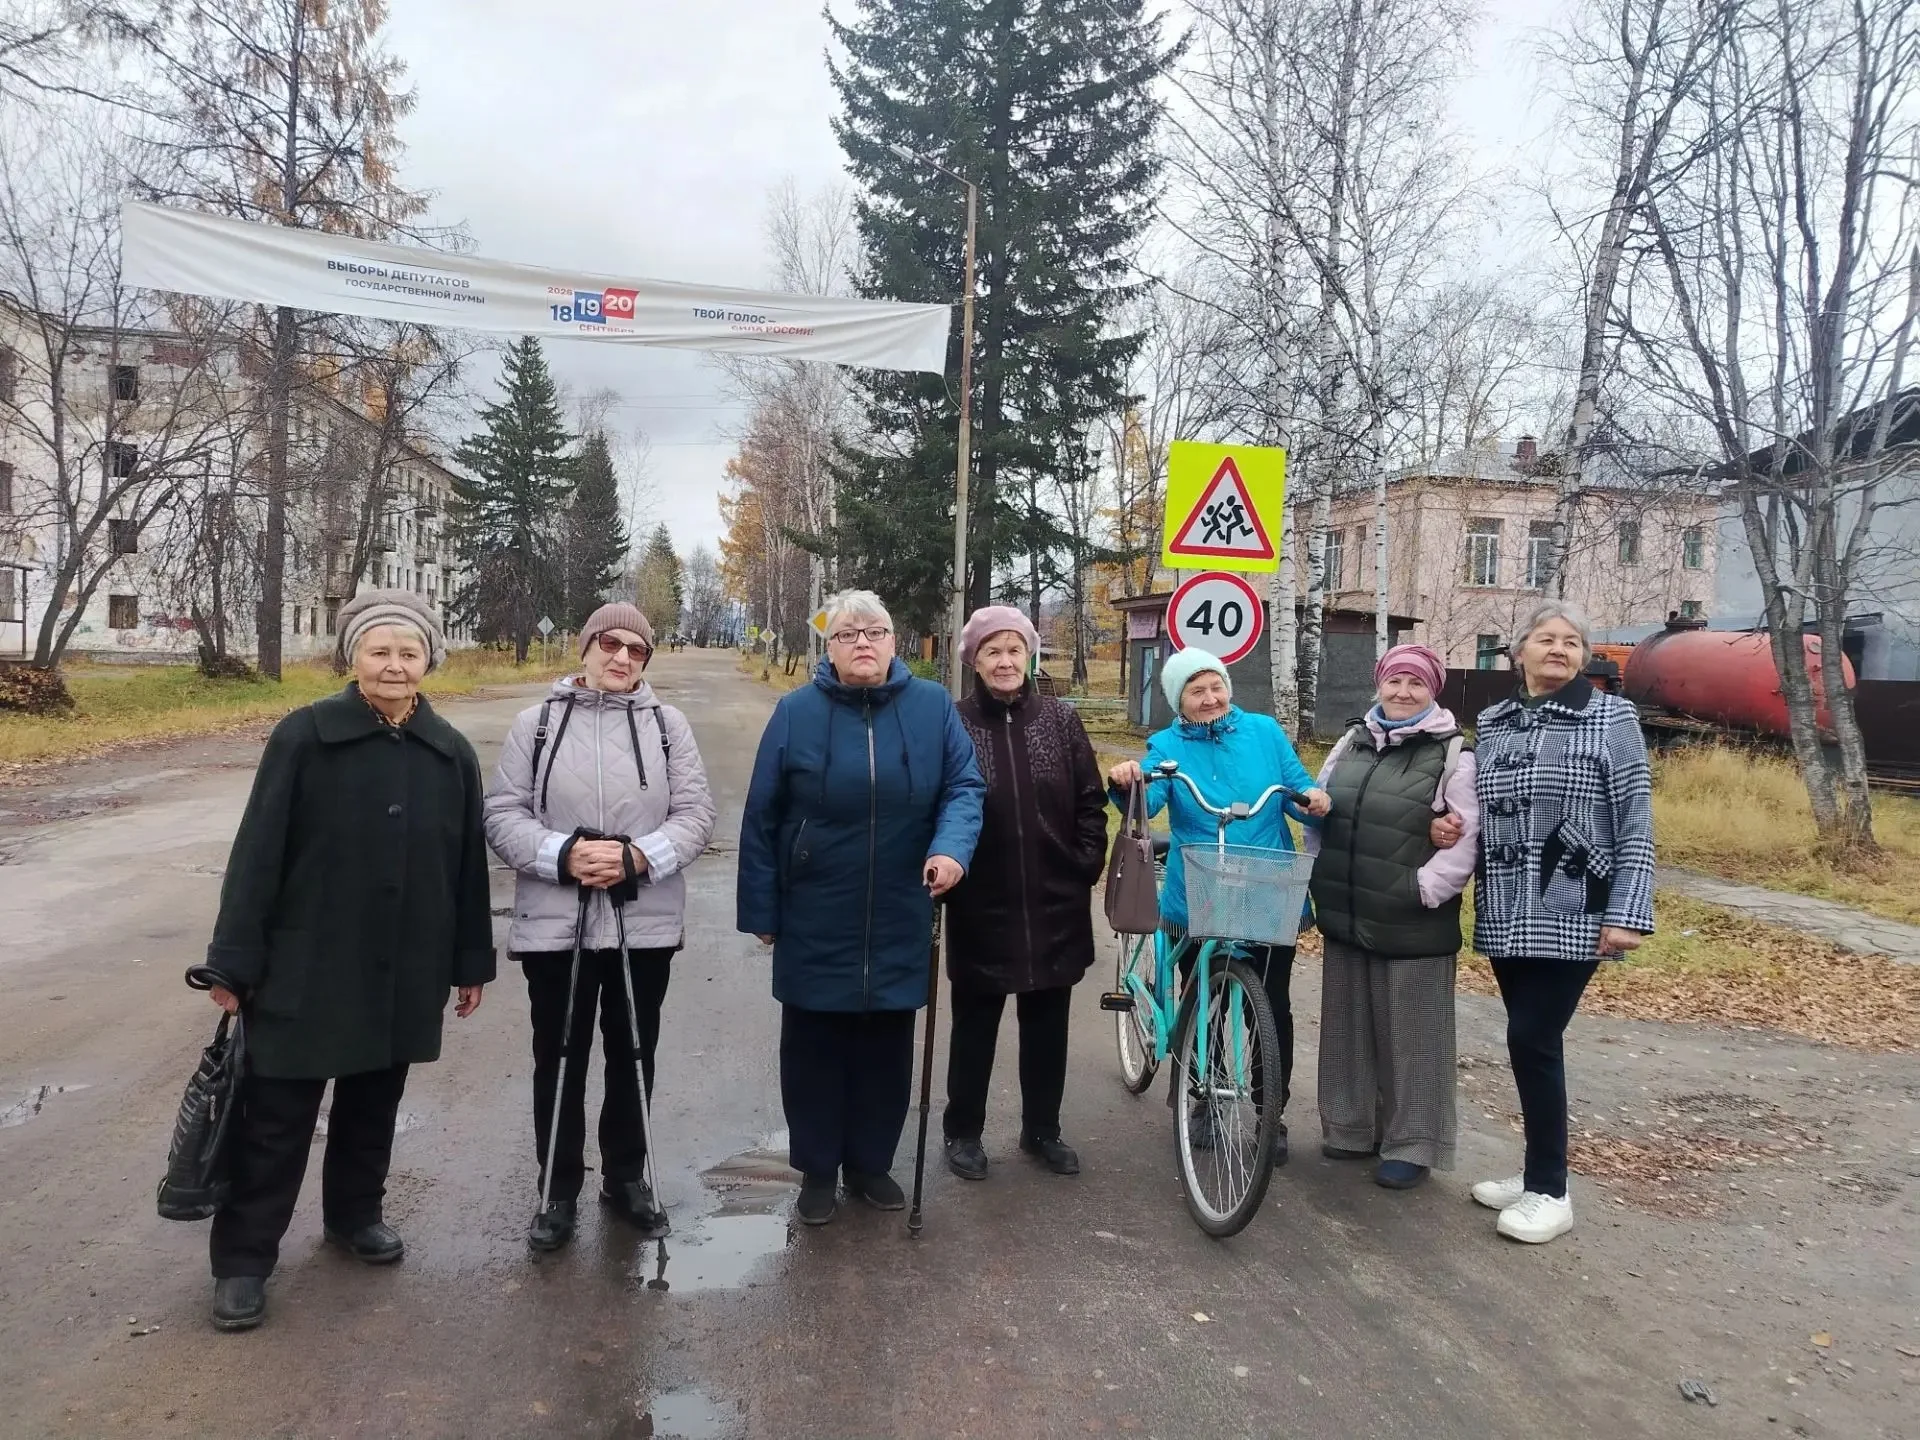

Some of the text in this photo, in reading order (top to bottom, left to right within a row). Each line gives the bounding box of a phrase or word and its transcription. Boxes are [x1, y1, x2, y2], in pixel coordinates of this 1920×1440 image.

[327, 260, 470, 289] ВЫБОРЫ ДЕПУТАТОВ
[345, 278, 485, 304] ГОСУДАРСТВЕННОЙ ДУМЫ
[550, 294, 633, 323] 18 19 20
[693, 308, 725, 320] ТВОЙ
[727, 312, 766, 324] ГОЛОС
[1186, 600, 1243, 637] 40
